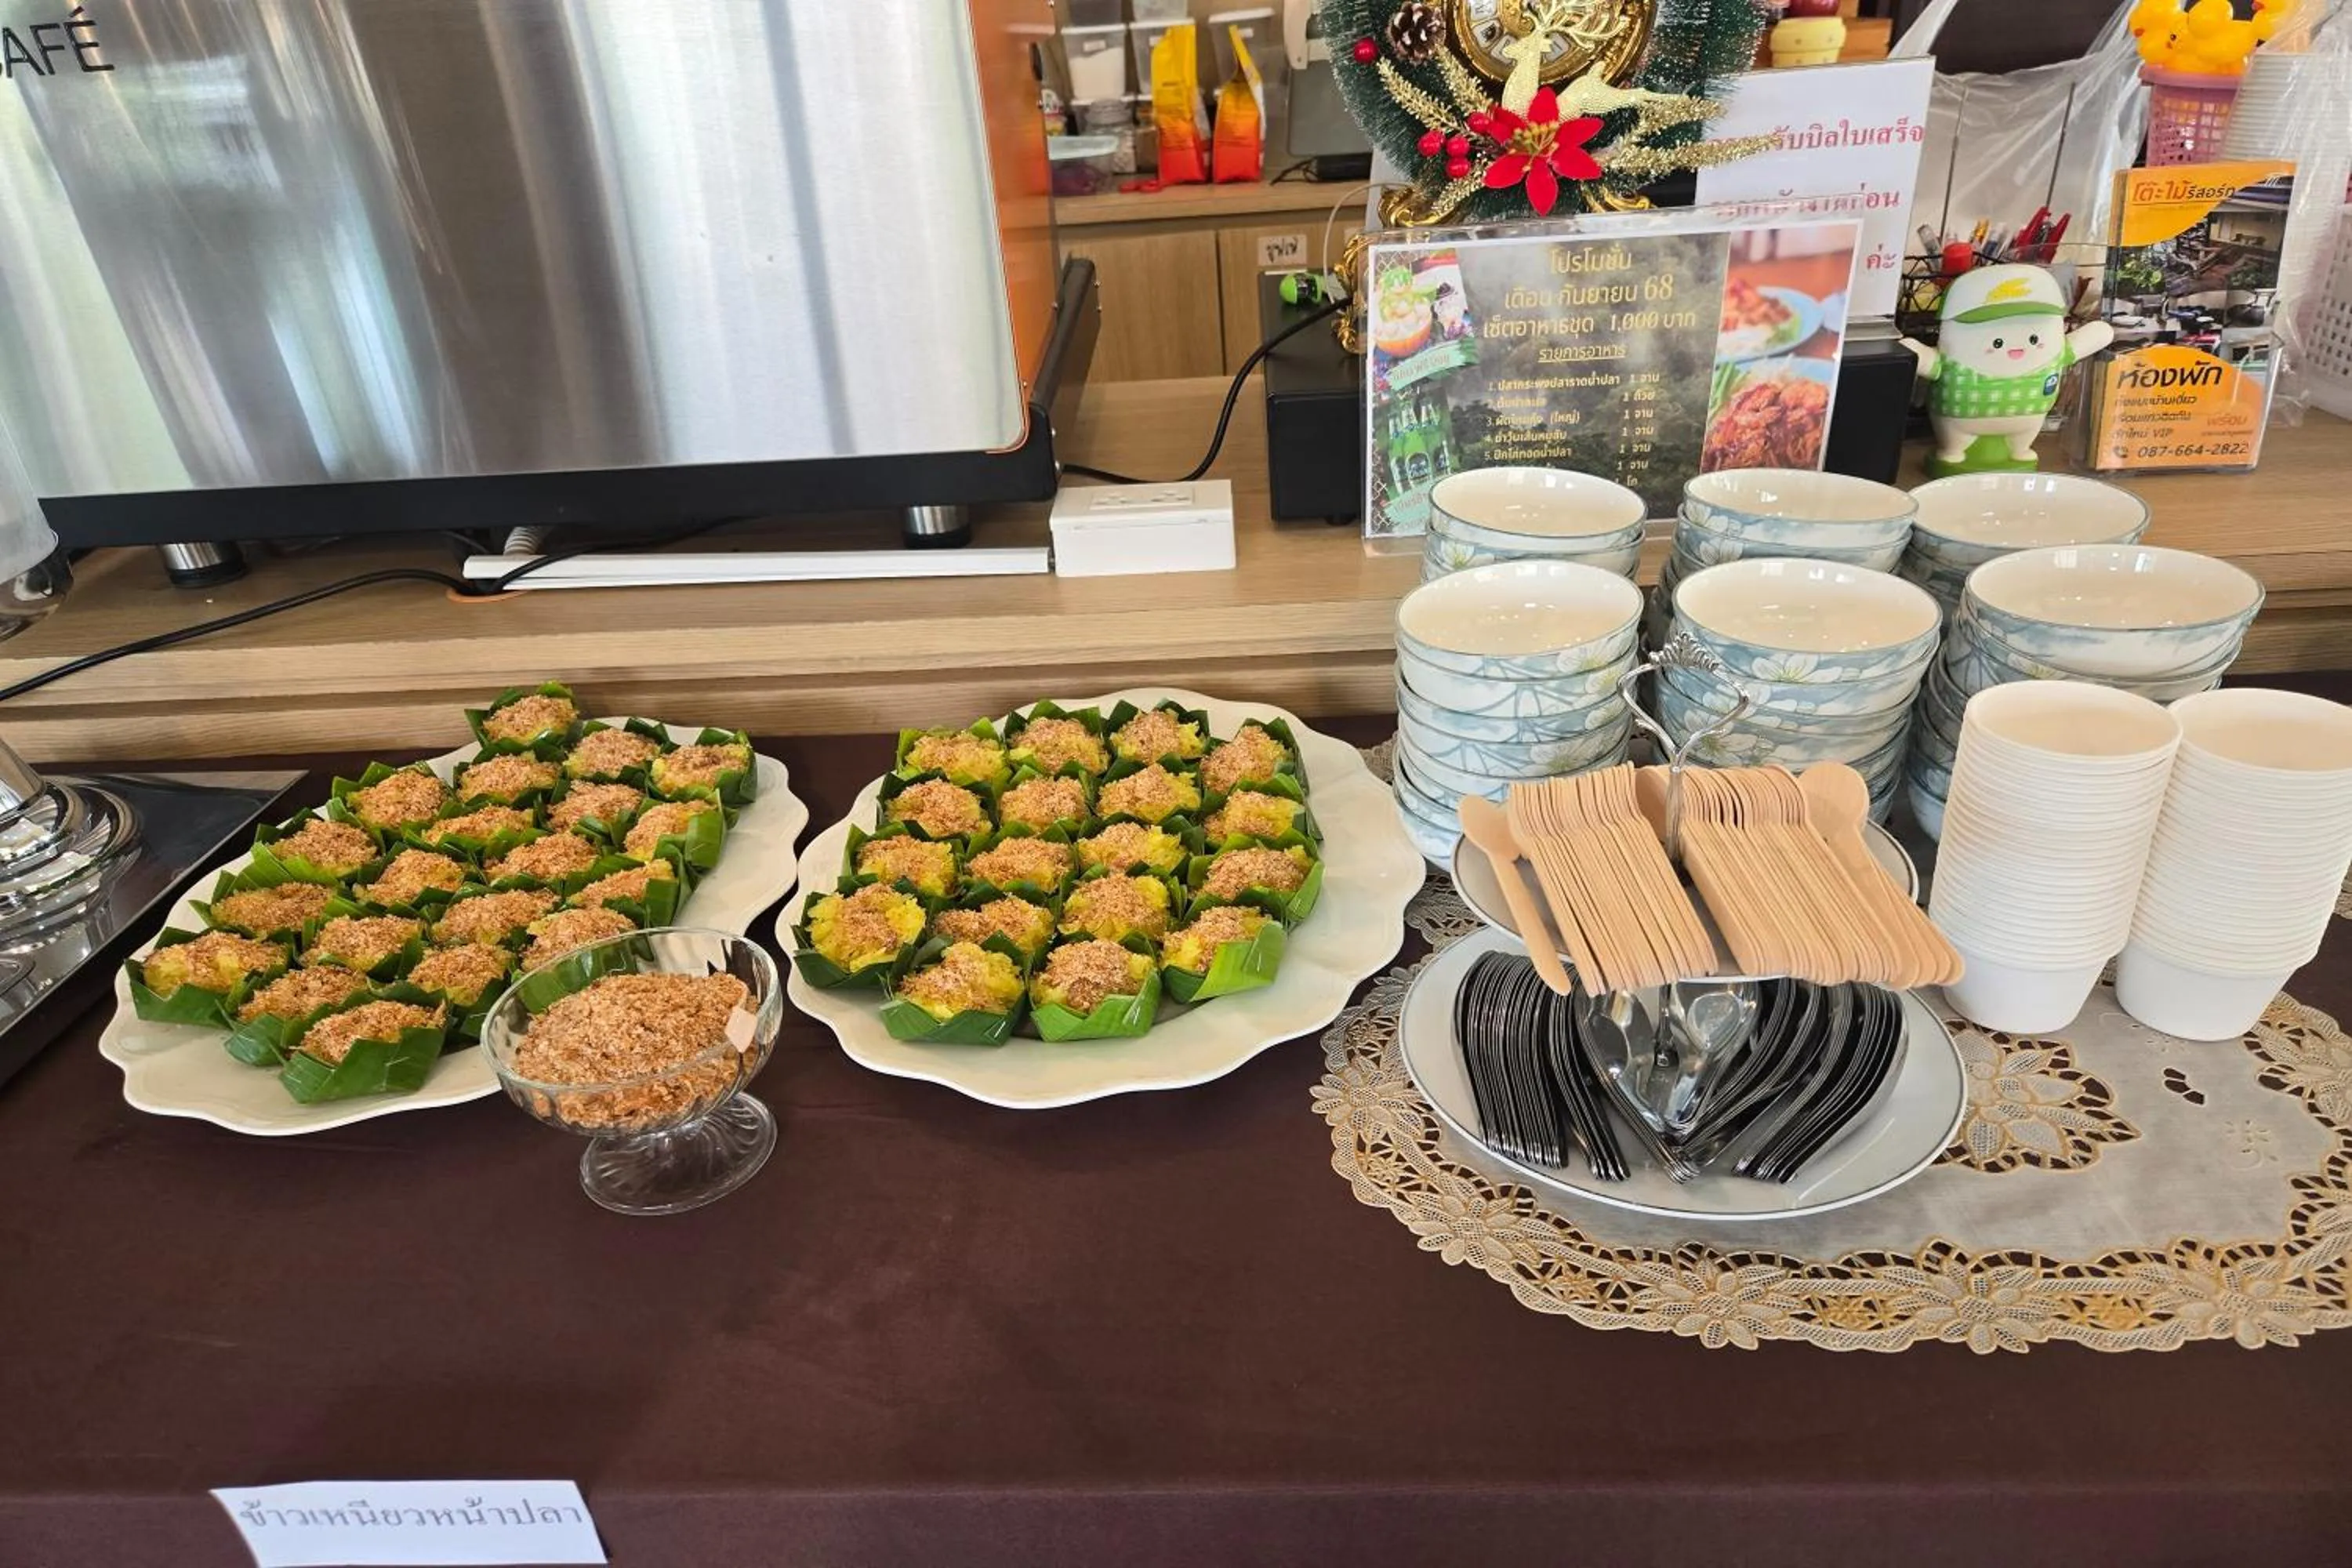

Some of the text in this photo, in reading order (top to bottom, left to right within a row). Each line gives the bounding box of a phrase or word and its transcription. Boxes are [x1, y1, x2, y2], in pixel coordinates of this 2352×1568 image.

[0, 5, 115, 78] AFÉ
[1550, 244, 1632, 274] โปรโมชั่น
[1866, 244, 1896, 269] ค่ะ
[1504, 274, 1674, 310] เดือน กันยายน 68
[1663, 312, 1697, 328] บาท
[2117, 360, 2223, 390] ห้องพัก
[2137, 442, 2251, 459] 087-664-2822
[239, 1497, 583, 1528] ข้าวเหนียวหน้าปลา
